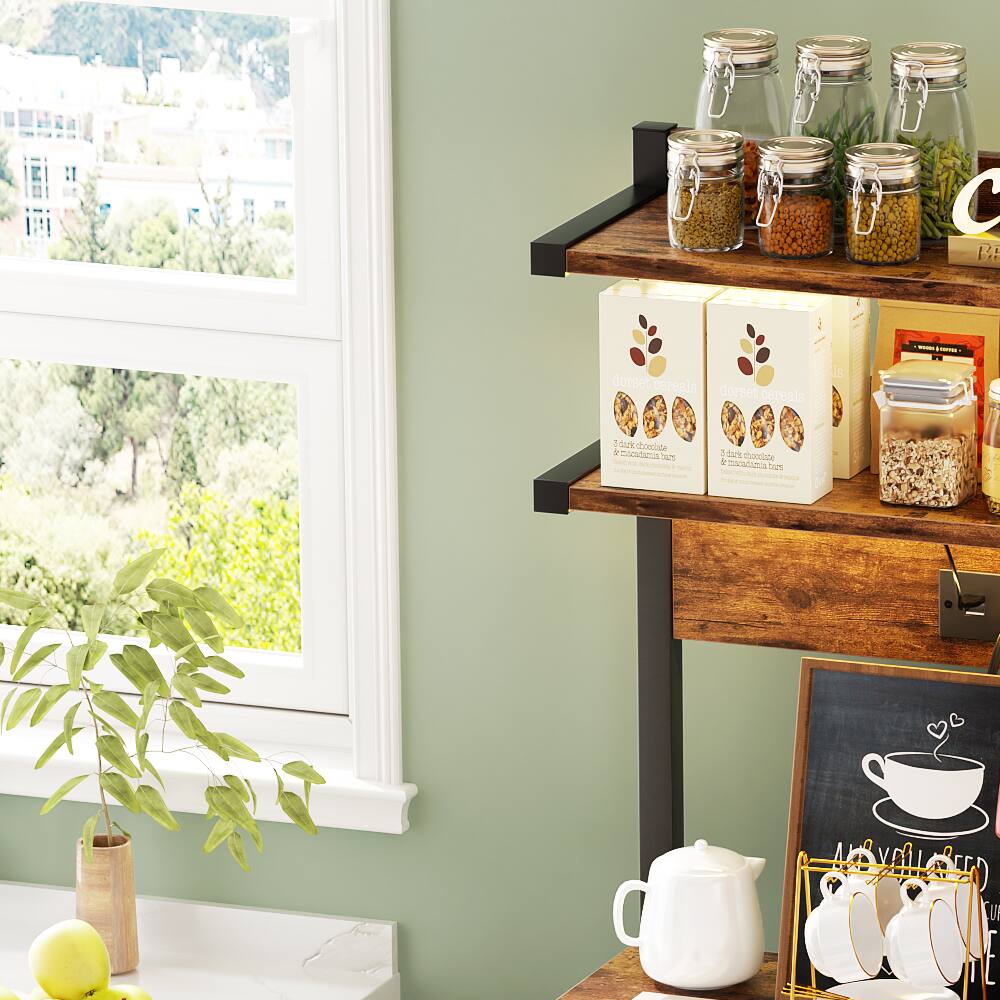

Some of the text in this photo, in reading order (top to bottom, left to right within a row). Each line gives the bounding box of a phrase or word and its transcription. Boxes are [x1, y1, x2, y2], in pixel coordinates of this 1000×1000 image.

[618, 439, 635, 449] dark
[635, 441, 668, 452] chocolate
[620, 449, 660, 461] macadamia
[660, 452, 676, 462] bars
[726, 449, 742, 459] dark
[743, 450, 775, 462] chocolate
[727, 458, 768, 470] macadamia
[768, 461, 784, 471] bars
